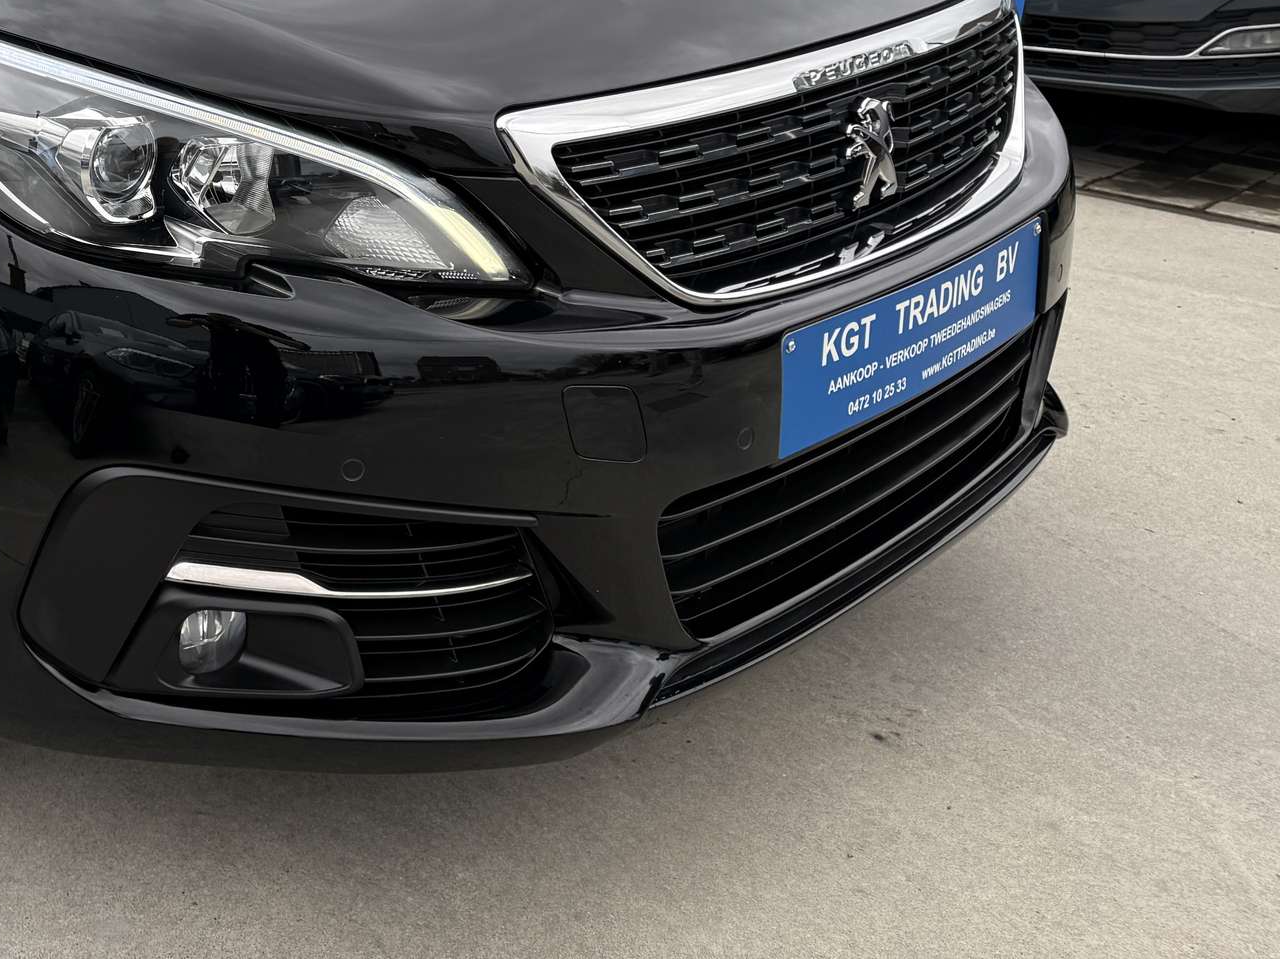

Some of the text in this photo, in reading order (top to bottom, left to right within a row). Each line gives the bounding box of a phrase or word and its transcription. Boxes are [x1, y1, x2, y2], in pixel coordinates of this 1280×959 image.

[821, 242, 1019, 366] KGT TRADING BV
[828, 362, 879, 395] AANKOOP
[885, 339, 929, 368] VERKOOP
[930, 290, 1011, 347] TWEEDEHANDSWAGENS
[848, 328, 996, 416] 0472 10 25 33 www.KGTTRADING.be
